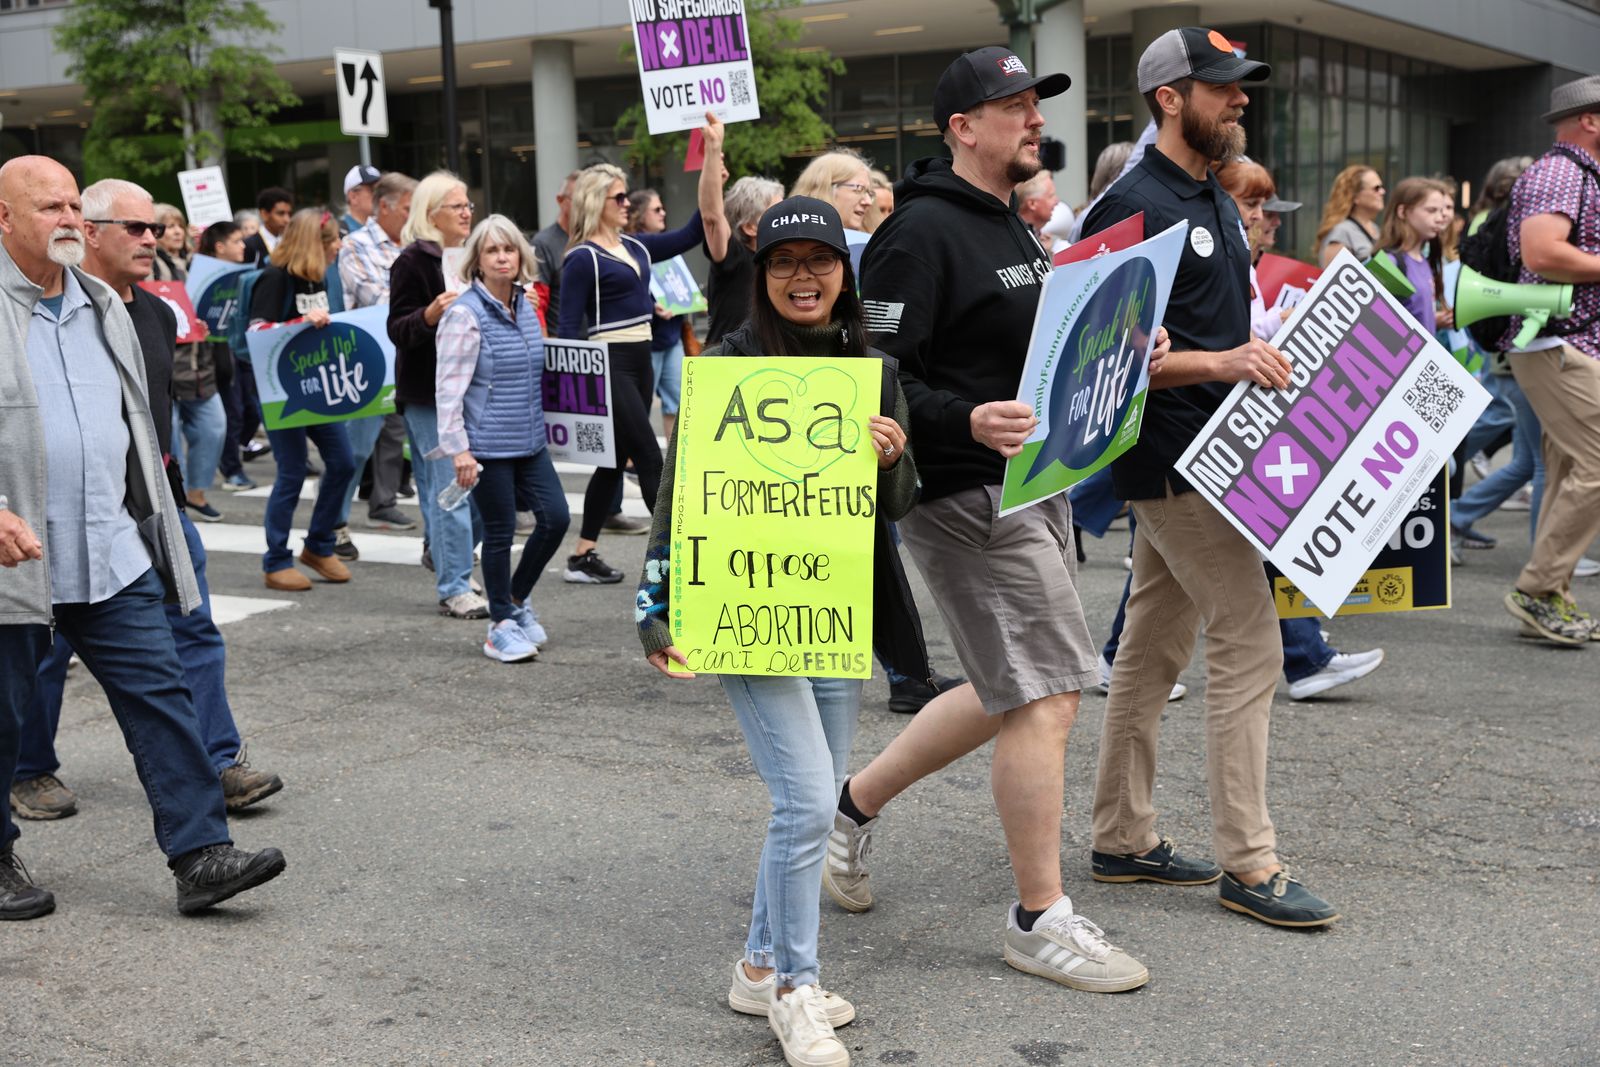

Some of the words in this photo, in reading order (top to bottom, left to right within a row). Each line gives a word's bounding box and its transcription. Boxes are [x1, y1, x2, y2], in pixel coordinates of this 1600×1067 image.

[682, 16, 748, 65] DEAL!
[650, 83, 696, 110] VOTE
[699, 77, 726, 105] NO
[771, 213, 827, 228] CHAPEL
[289, 339, 329, 376] Speak
[333, 329, 358, 362] Up!
[1036, 271, 1099, 421] amilyFoundation.org
[1073, 298, 1123, 383] Speak
[1122, 276, 1150, 346] Up!
[300, 376, 322, 395] FOR
[318, 352, 368, 406] Life
[544, 346, 604, 375] UARDS
[1069, 385, 1090, 425] FOR
[1083, 328, 1134, 445] Life
[1287, 297, 1424, 463] DEAL!
[542, 373, 607, 416] EAL!
[684, 361, 694, 430] CHOICE
[807, 402, 856, 454] a
[1191, 437, 1244, 498] NO
[677, 485, 686, 534] THOSE
[1292, 479, 1376, 577] VOTE
[1361, 421, 1419, 490] NO
[688, 536, 707, 586] I
[728, 549, 830, 588] oppose
[713, 603, 853, 647] ABORTION
